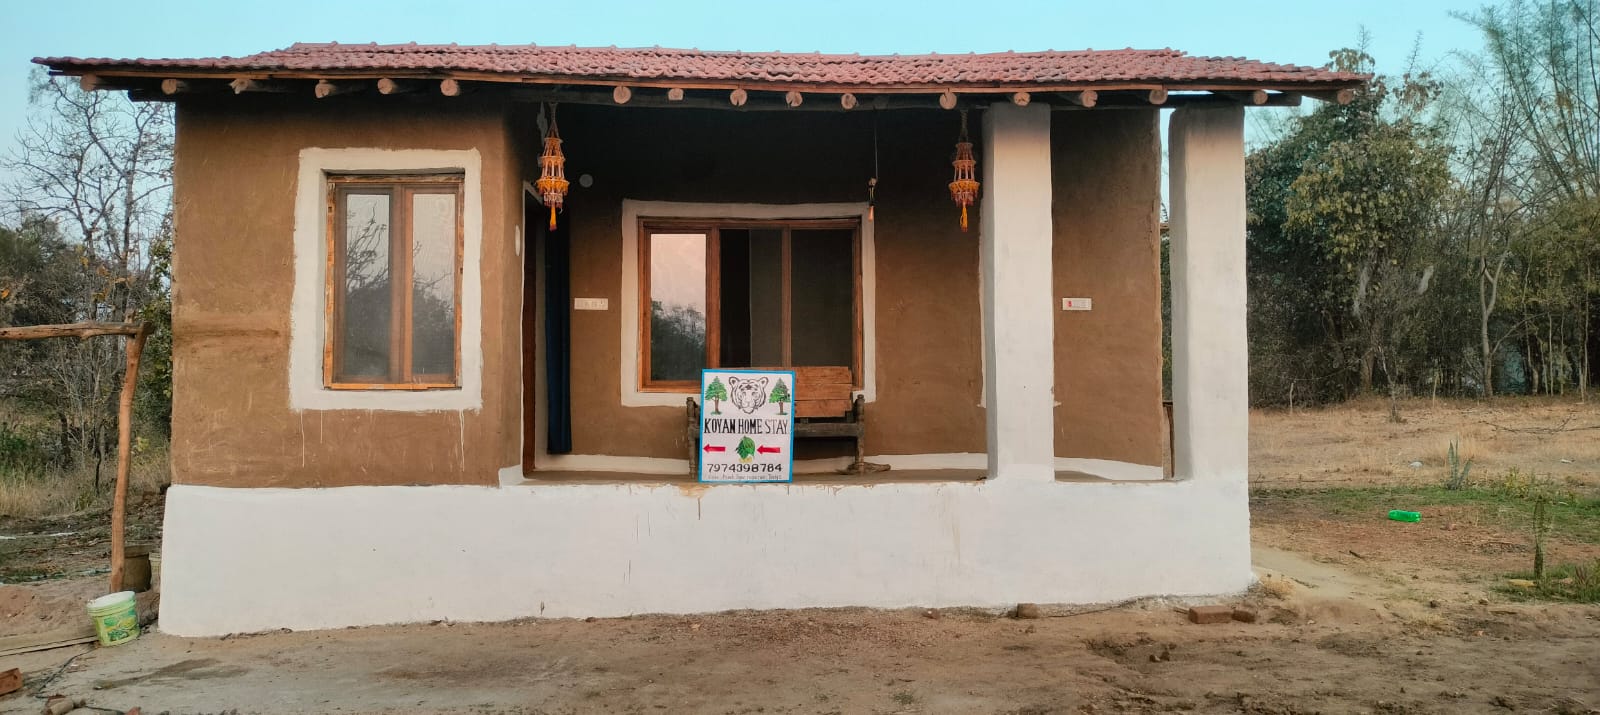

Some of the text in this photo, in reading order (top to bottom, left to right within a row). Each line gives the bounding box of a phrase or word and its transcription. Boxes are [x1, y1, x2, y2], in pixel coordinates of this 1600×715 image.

[704, 418, 788, 434] KOYAN HOME STAY
